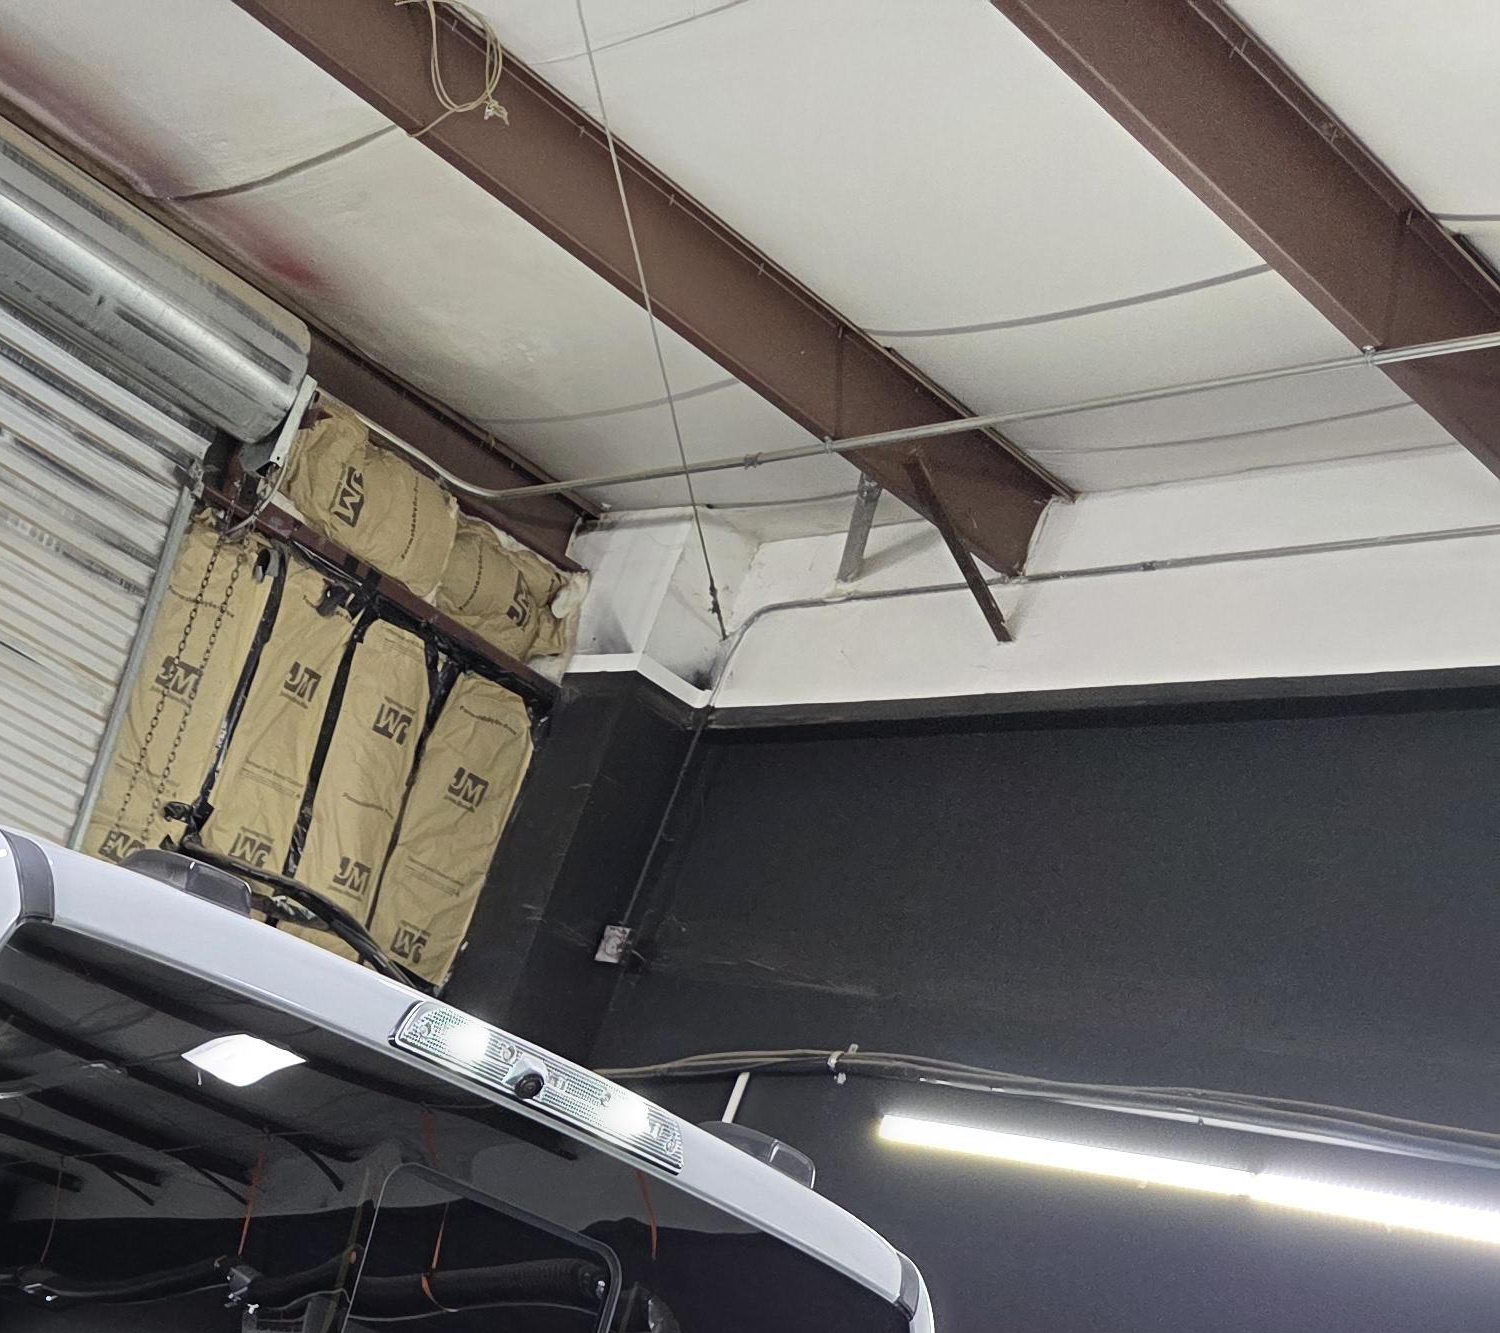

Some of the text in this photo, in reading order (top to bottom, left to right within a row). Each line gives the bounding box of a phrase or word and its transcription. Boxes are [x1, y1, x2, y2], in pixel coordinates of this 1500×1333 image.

[332, 465, 365, 528] JM
[448, 766, 489, 808] JM
[333, 856, 371, 896] JM
